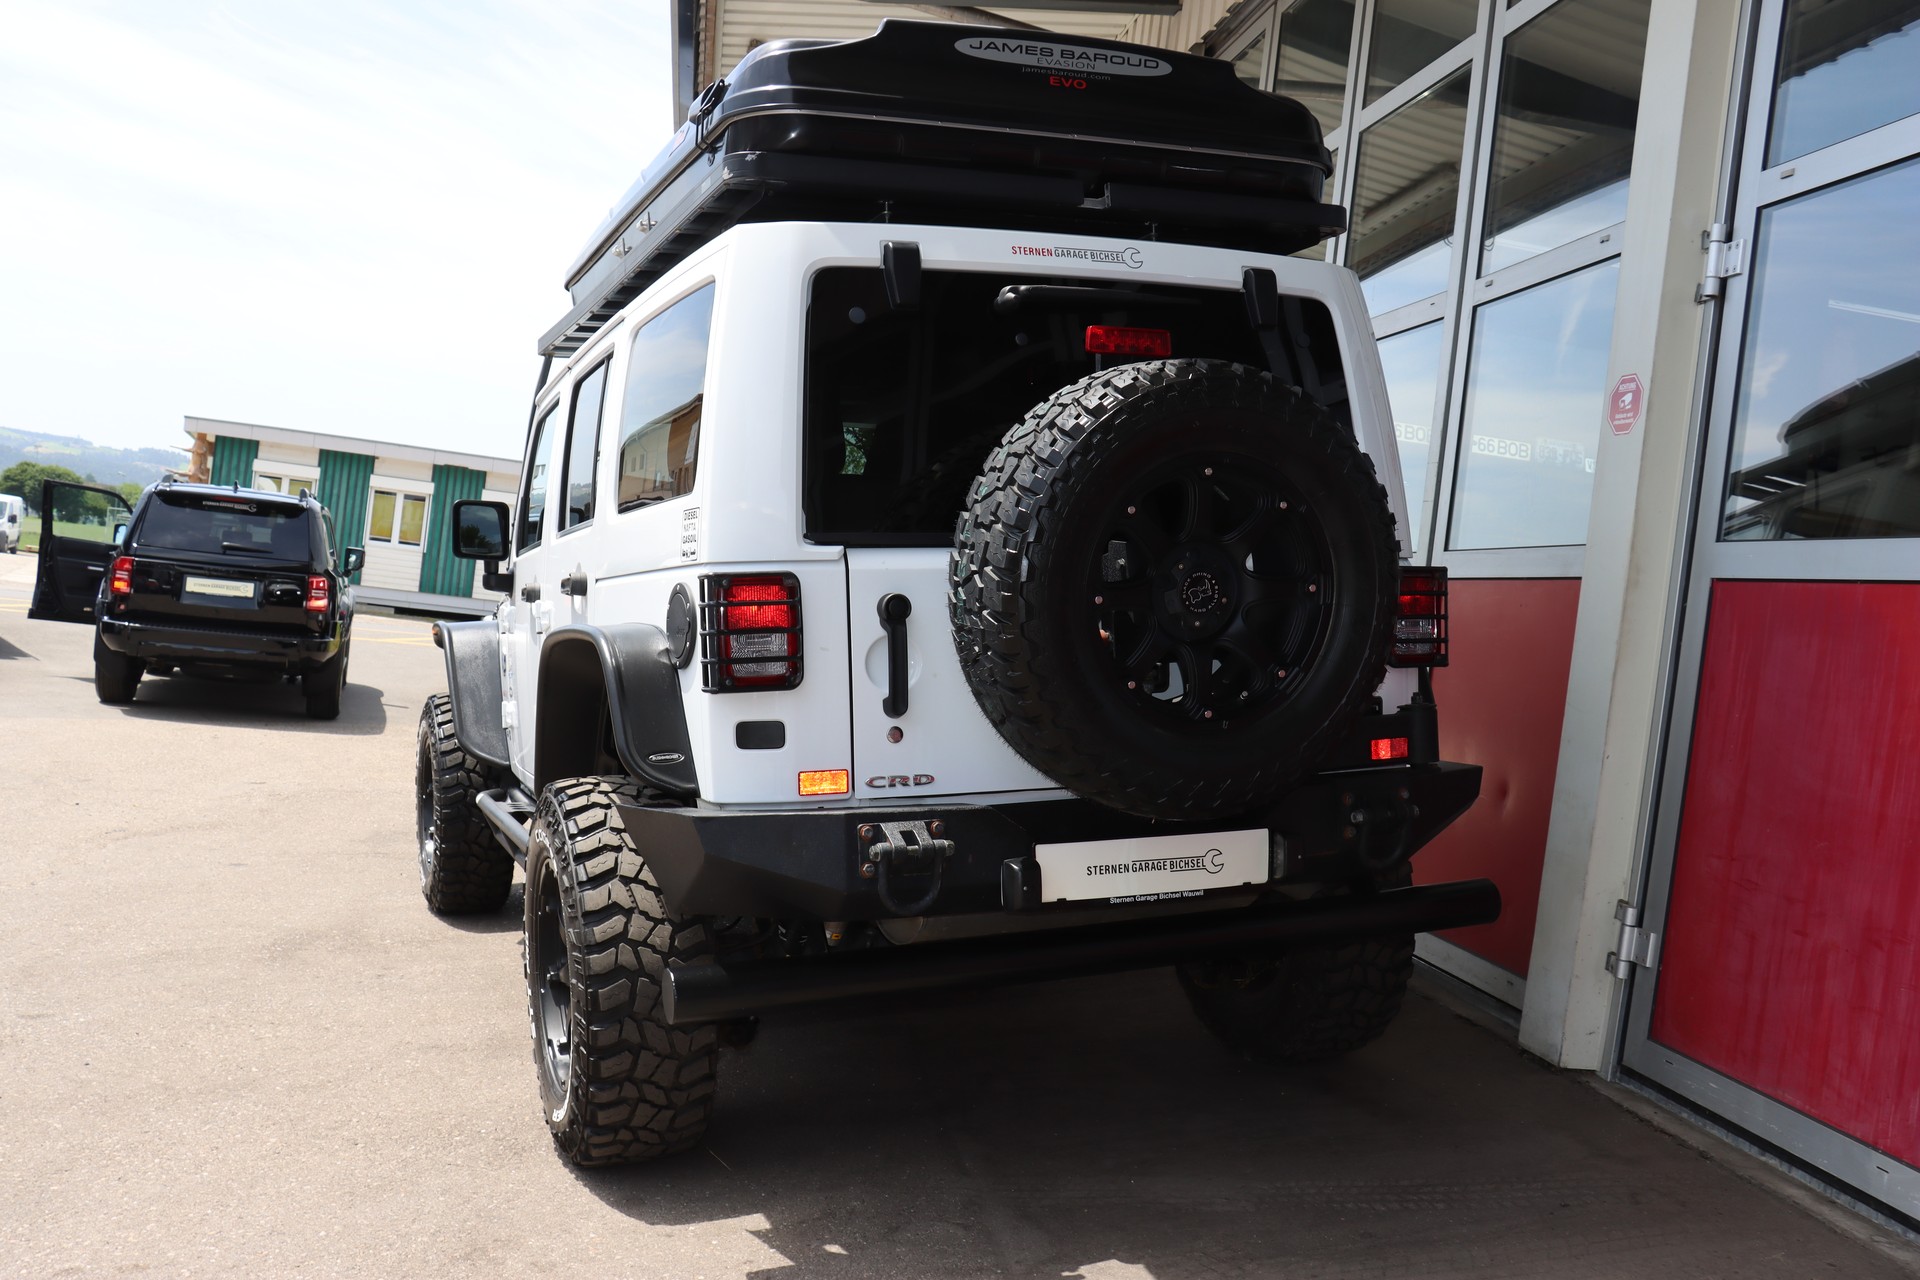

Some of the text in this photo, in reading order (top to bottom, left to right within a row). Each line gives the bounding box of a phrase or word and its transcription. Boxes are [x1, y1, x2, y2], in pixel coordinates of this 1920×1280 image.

[970, 40, 1160, 70] JAMES BAROUD
[1037, 58, 1096, 70] EVASION
[1022, 66, 1111, 81] jamesbaroud.com
[1049, 76, 1087, 90] EVO
[1011, 246, 1126, 262] STERNEN GARAGE BICHSEL
[684, 510, 698, 521] DIESEL
[682, 534, 697, 544] GASOIL
[864, 774, 935, 788] CRD
[1086, 858, 1206, 876] STERNEN GARAGE BICHSEL
[1110, 890, 1204, 904] Sternen Garage Bichsel Wauwil
